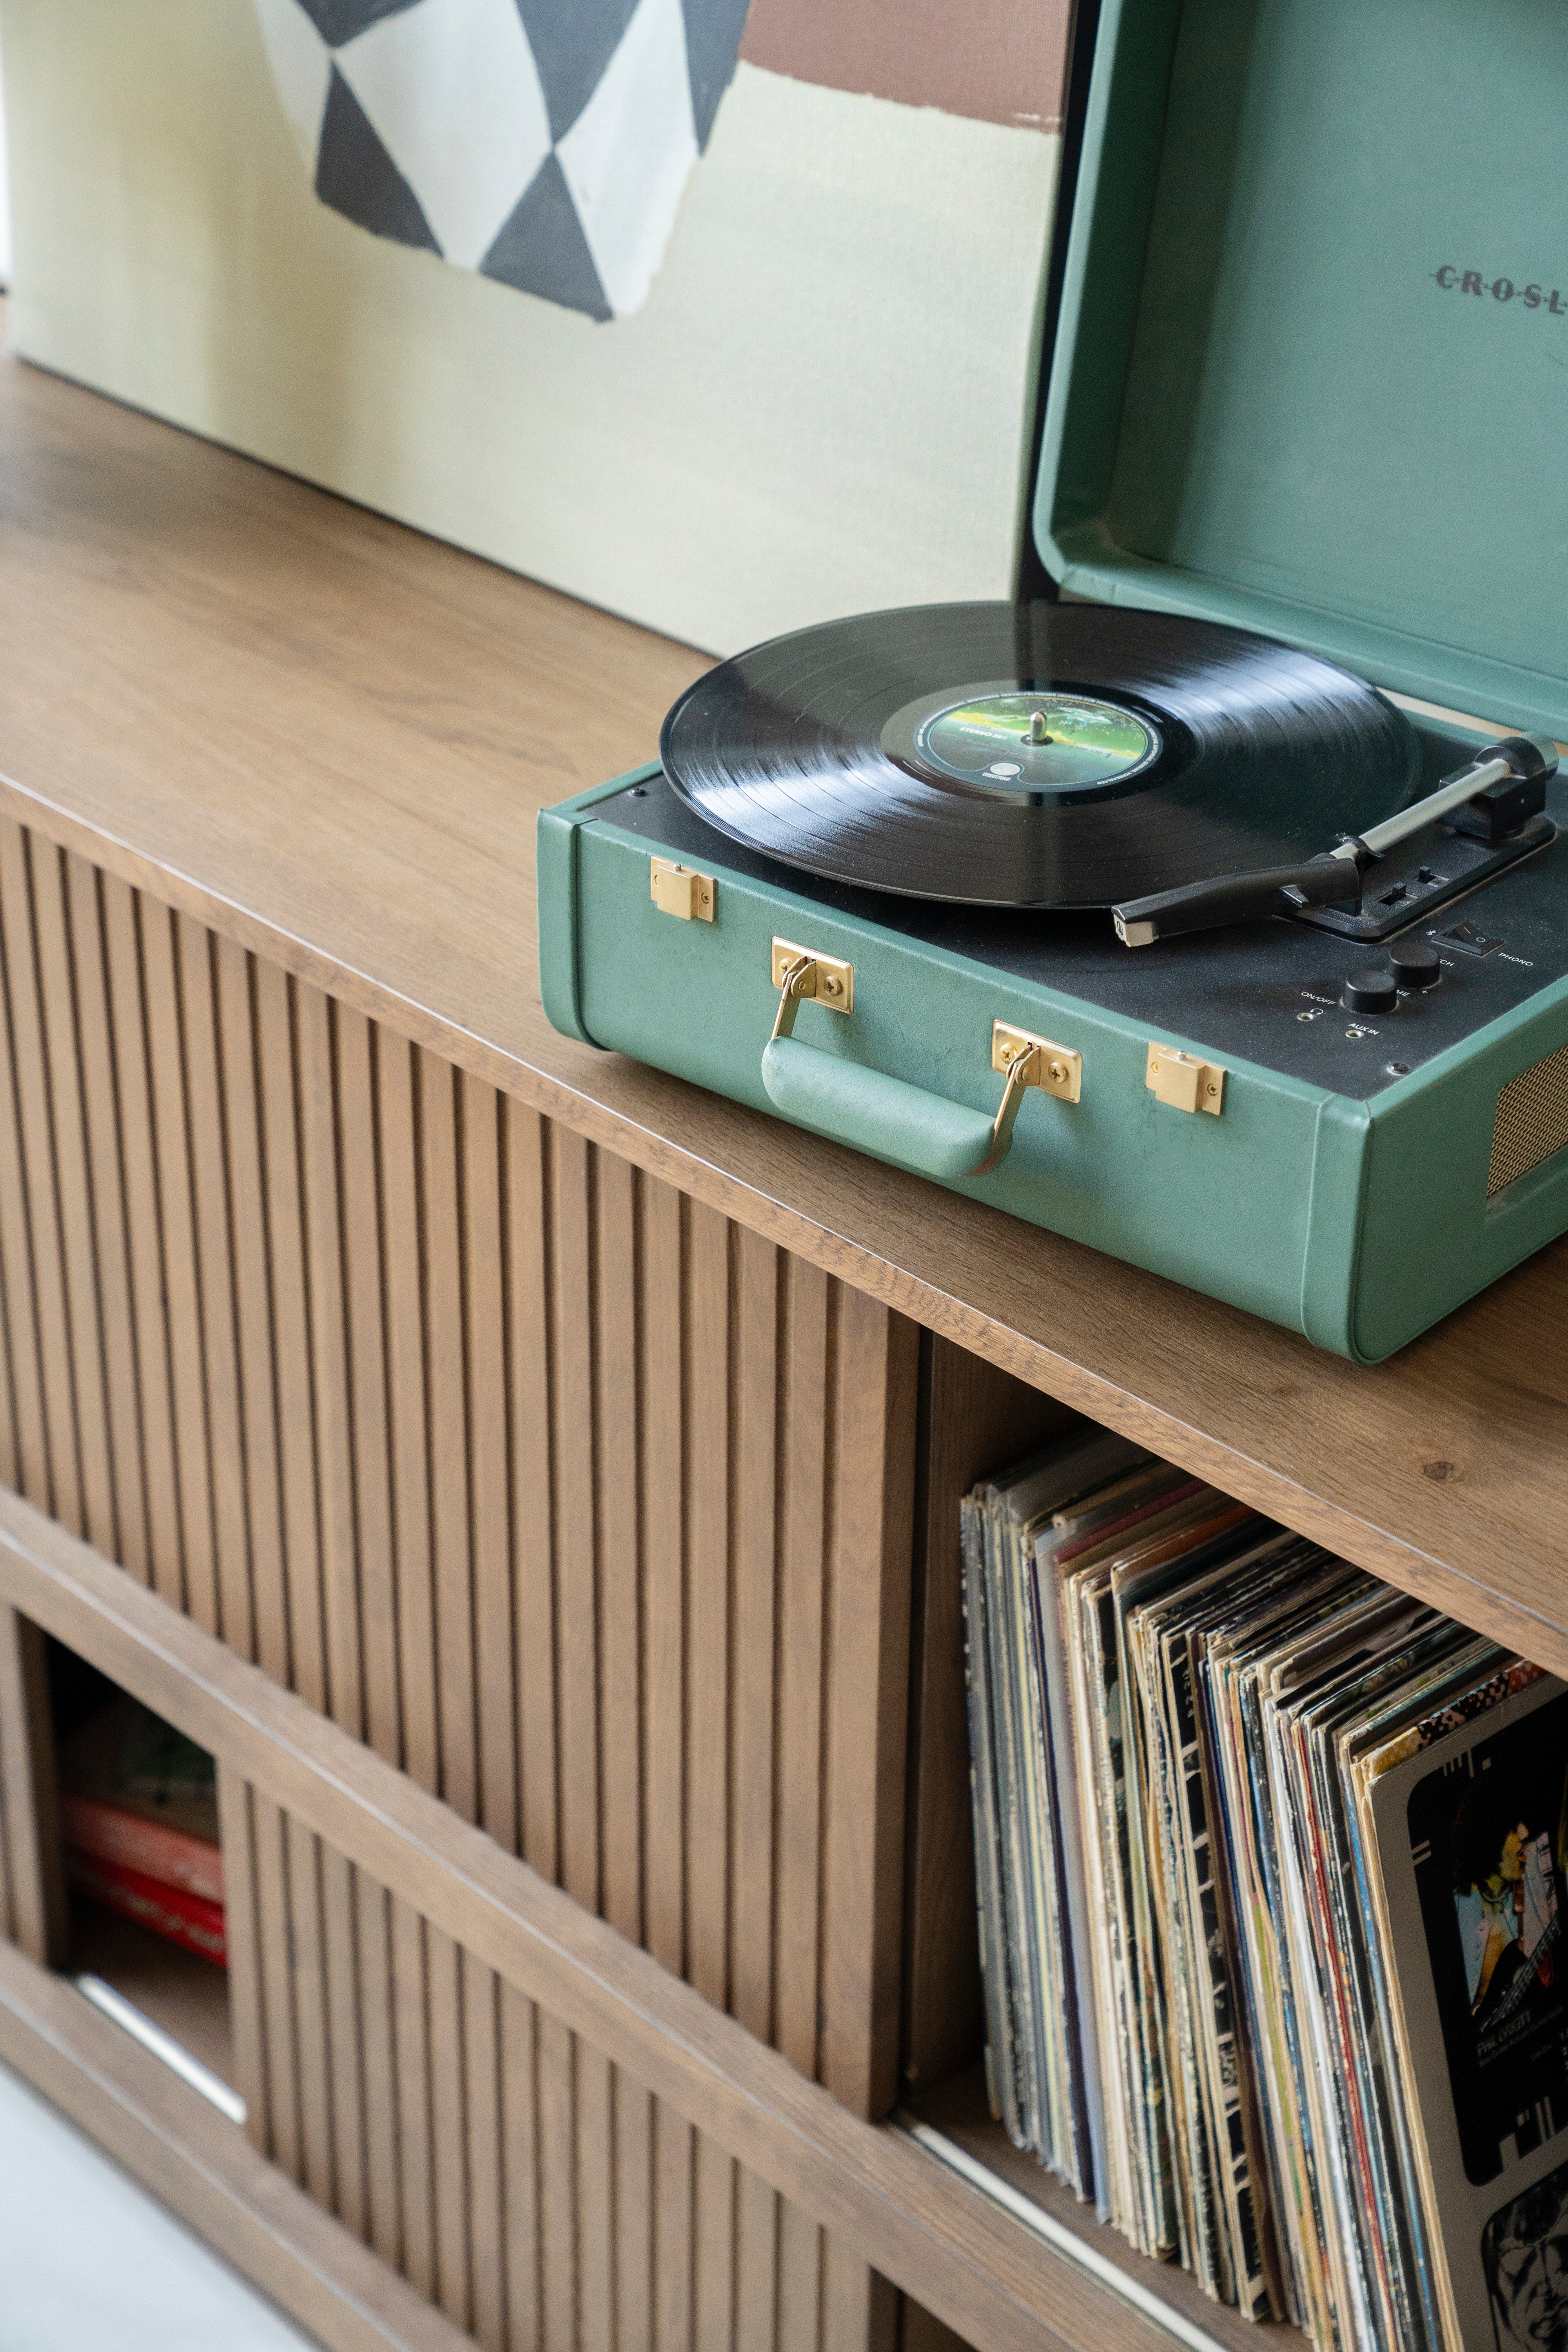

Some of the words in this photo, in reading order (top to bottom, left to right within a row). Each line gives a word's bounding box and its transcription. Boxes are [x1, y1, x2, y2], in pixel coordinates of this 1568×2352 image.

[960, 727, 993, 736] STEREO
[1498, 953, 1533, 966] PHONO
[1301, 992, 1336, 1005] ON/OFF
[1348, 1023, 1370, 1032] AUX
